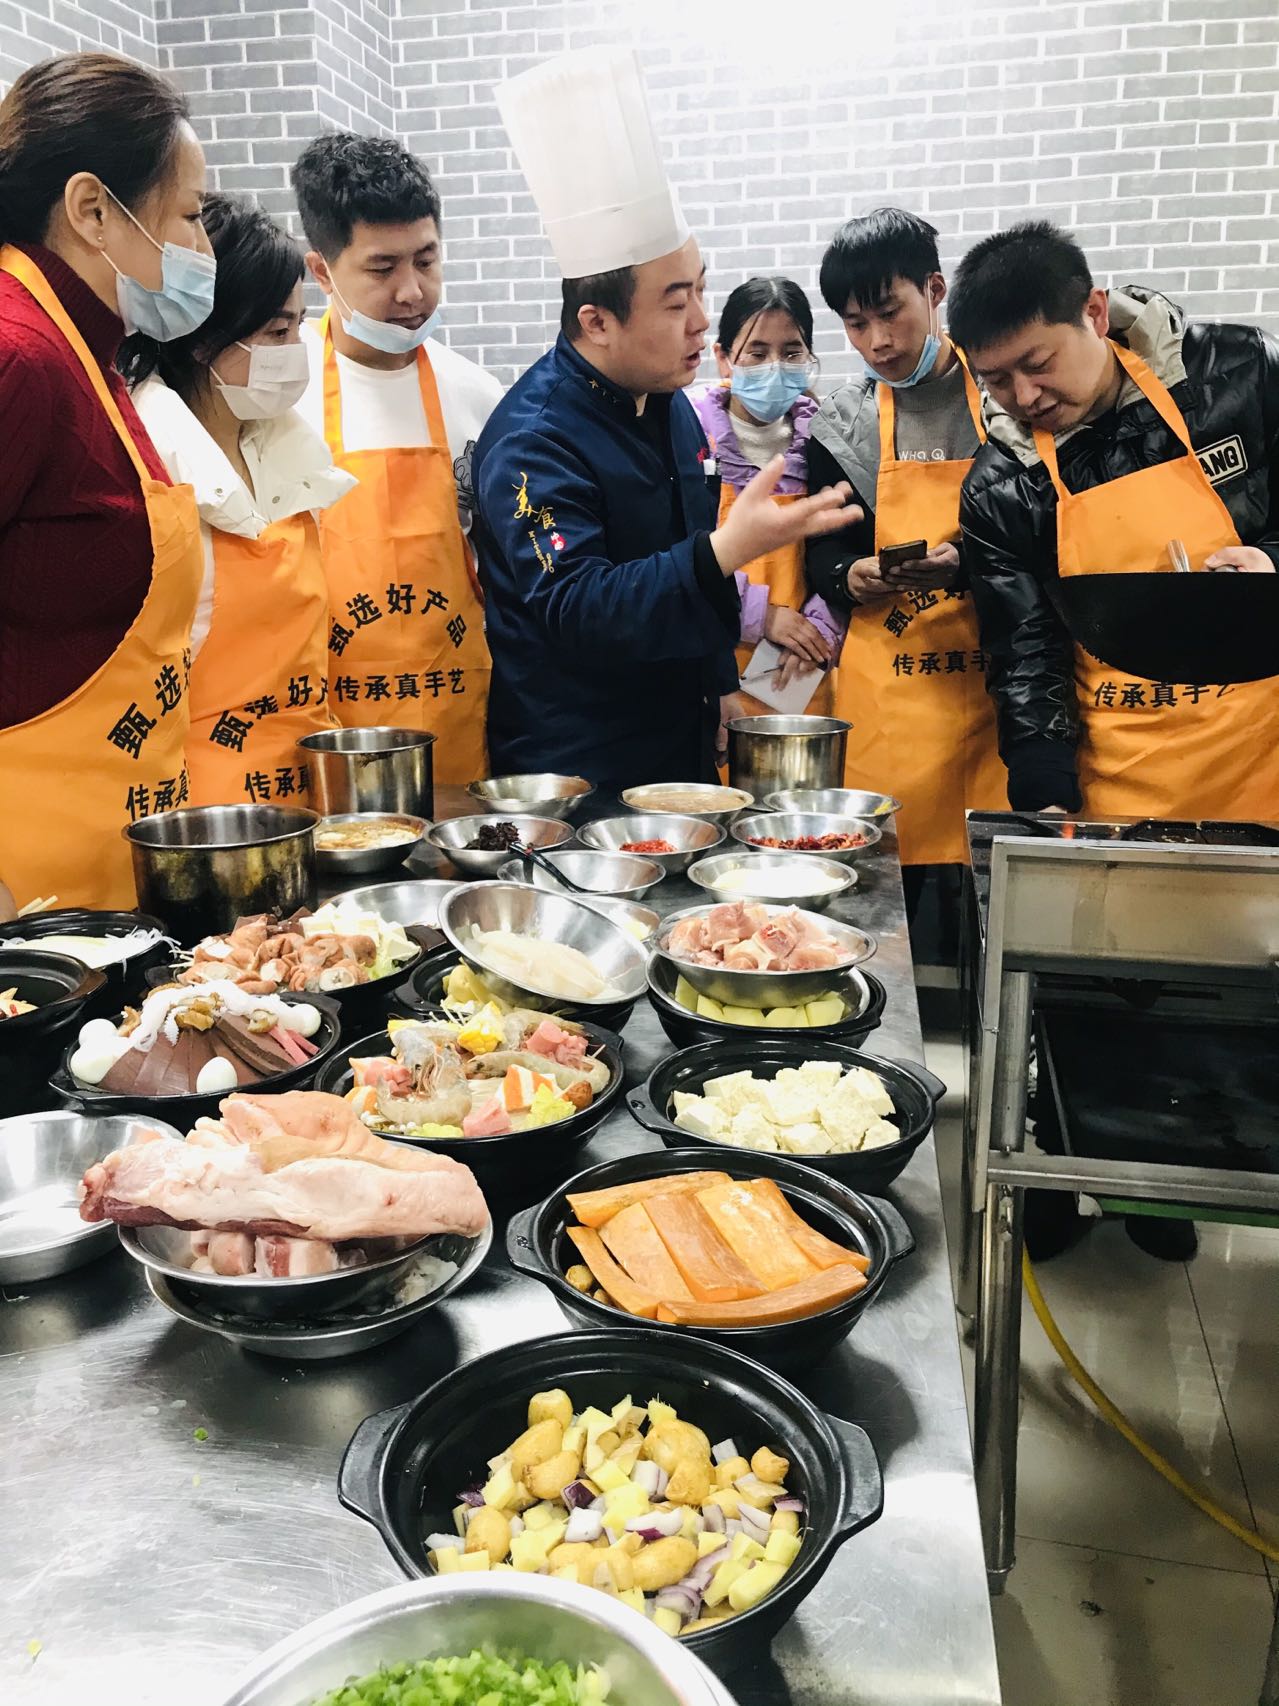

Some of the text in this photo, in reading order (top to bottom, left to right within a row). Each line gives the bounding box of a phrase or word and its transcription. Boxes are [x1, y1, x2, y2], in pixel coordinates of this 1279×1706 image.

[328, 583, 467, 657] 甄选好产品
[883, 587, 965, 638] 甄选
[334, 668, 466, 702] 传承真手艺
